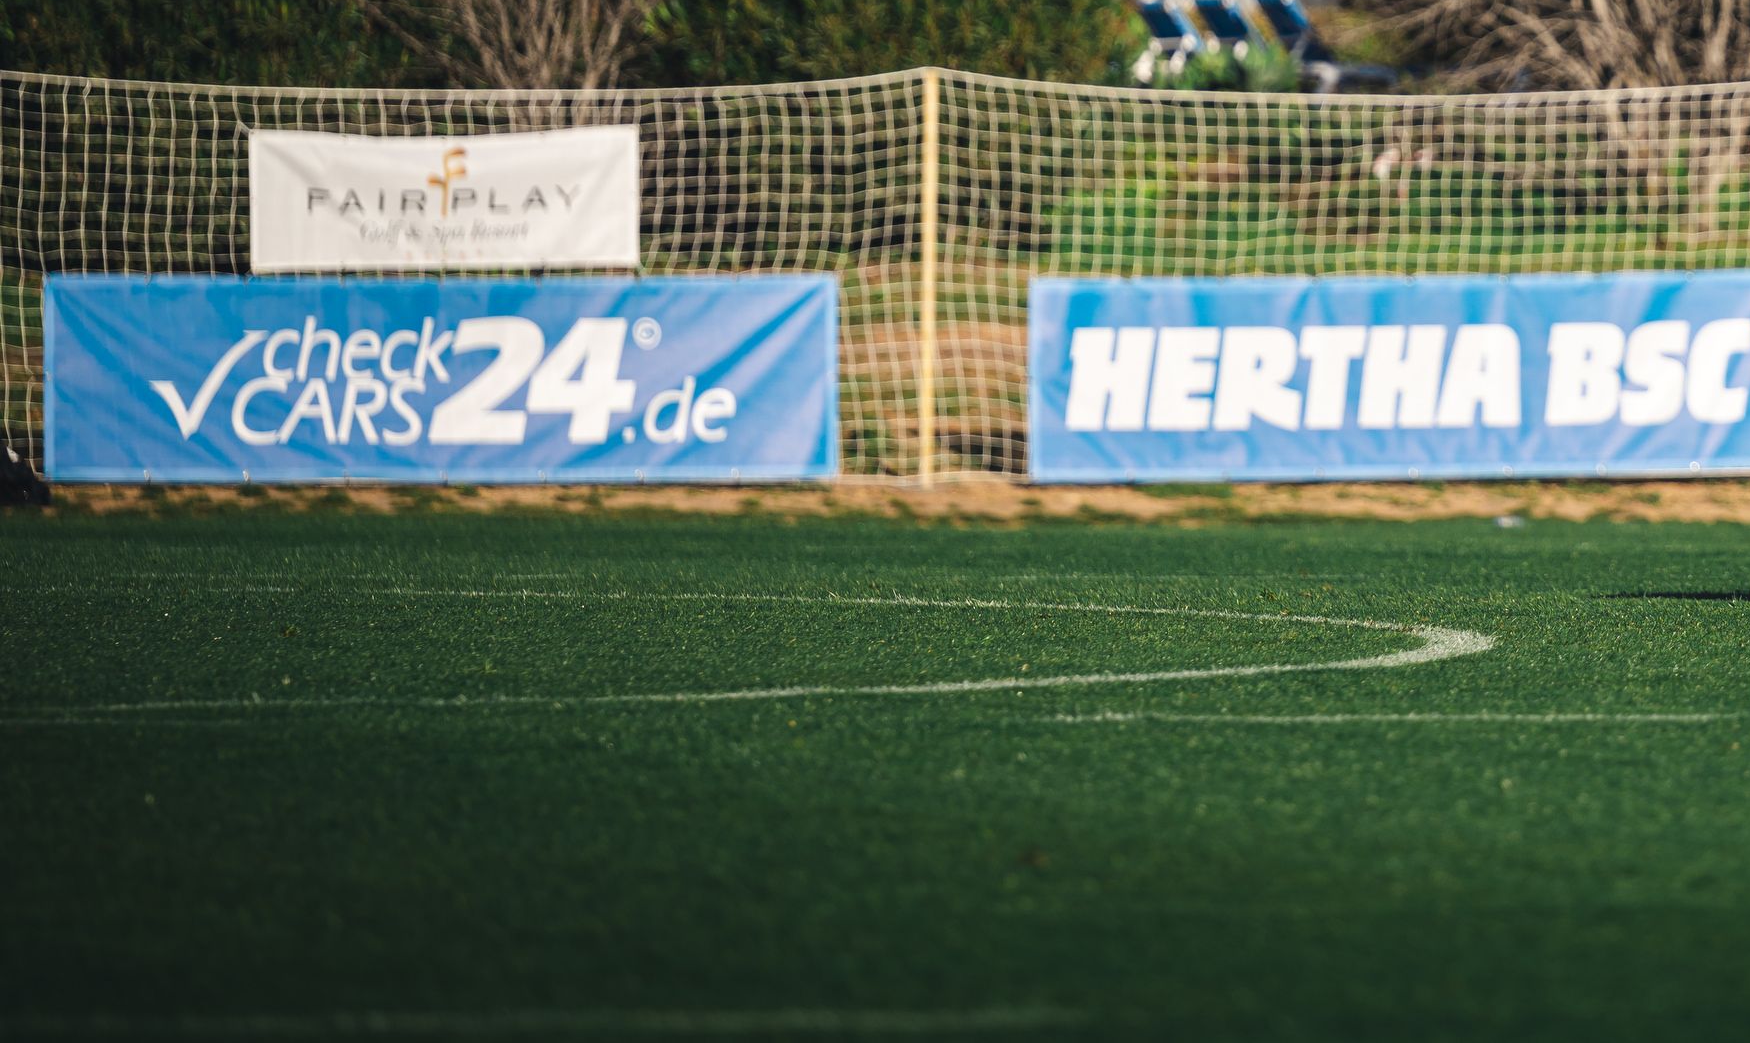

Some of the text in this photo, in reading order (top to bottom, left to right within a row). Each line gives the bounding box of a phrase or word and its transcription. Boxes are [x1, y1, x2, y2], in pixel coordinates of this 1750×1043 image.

[261, 315, 457, 384] check
[1064, 323, 1522, 433] HERTHA
[231, 377, 427, 446] CARS
